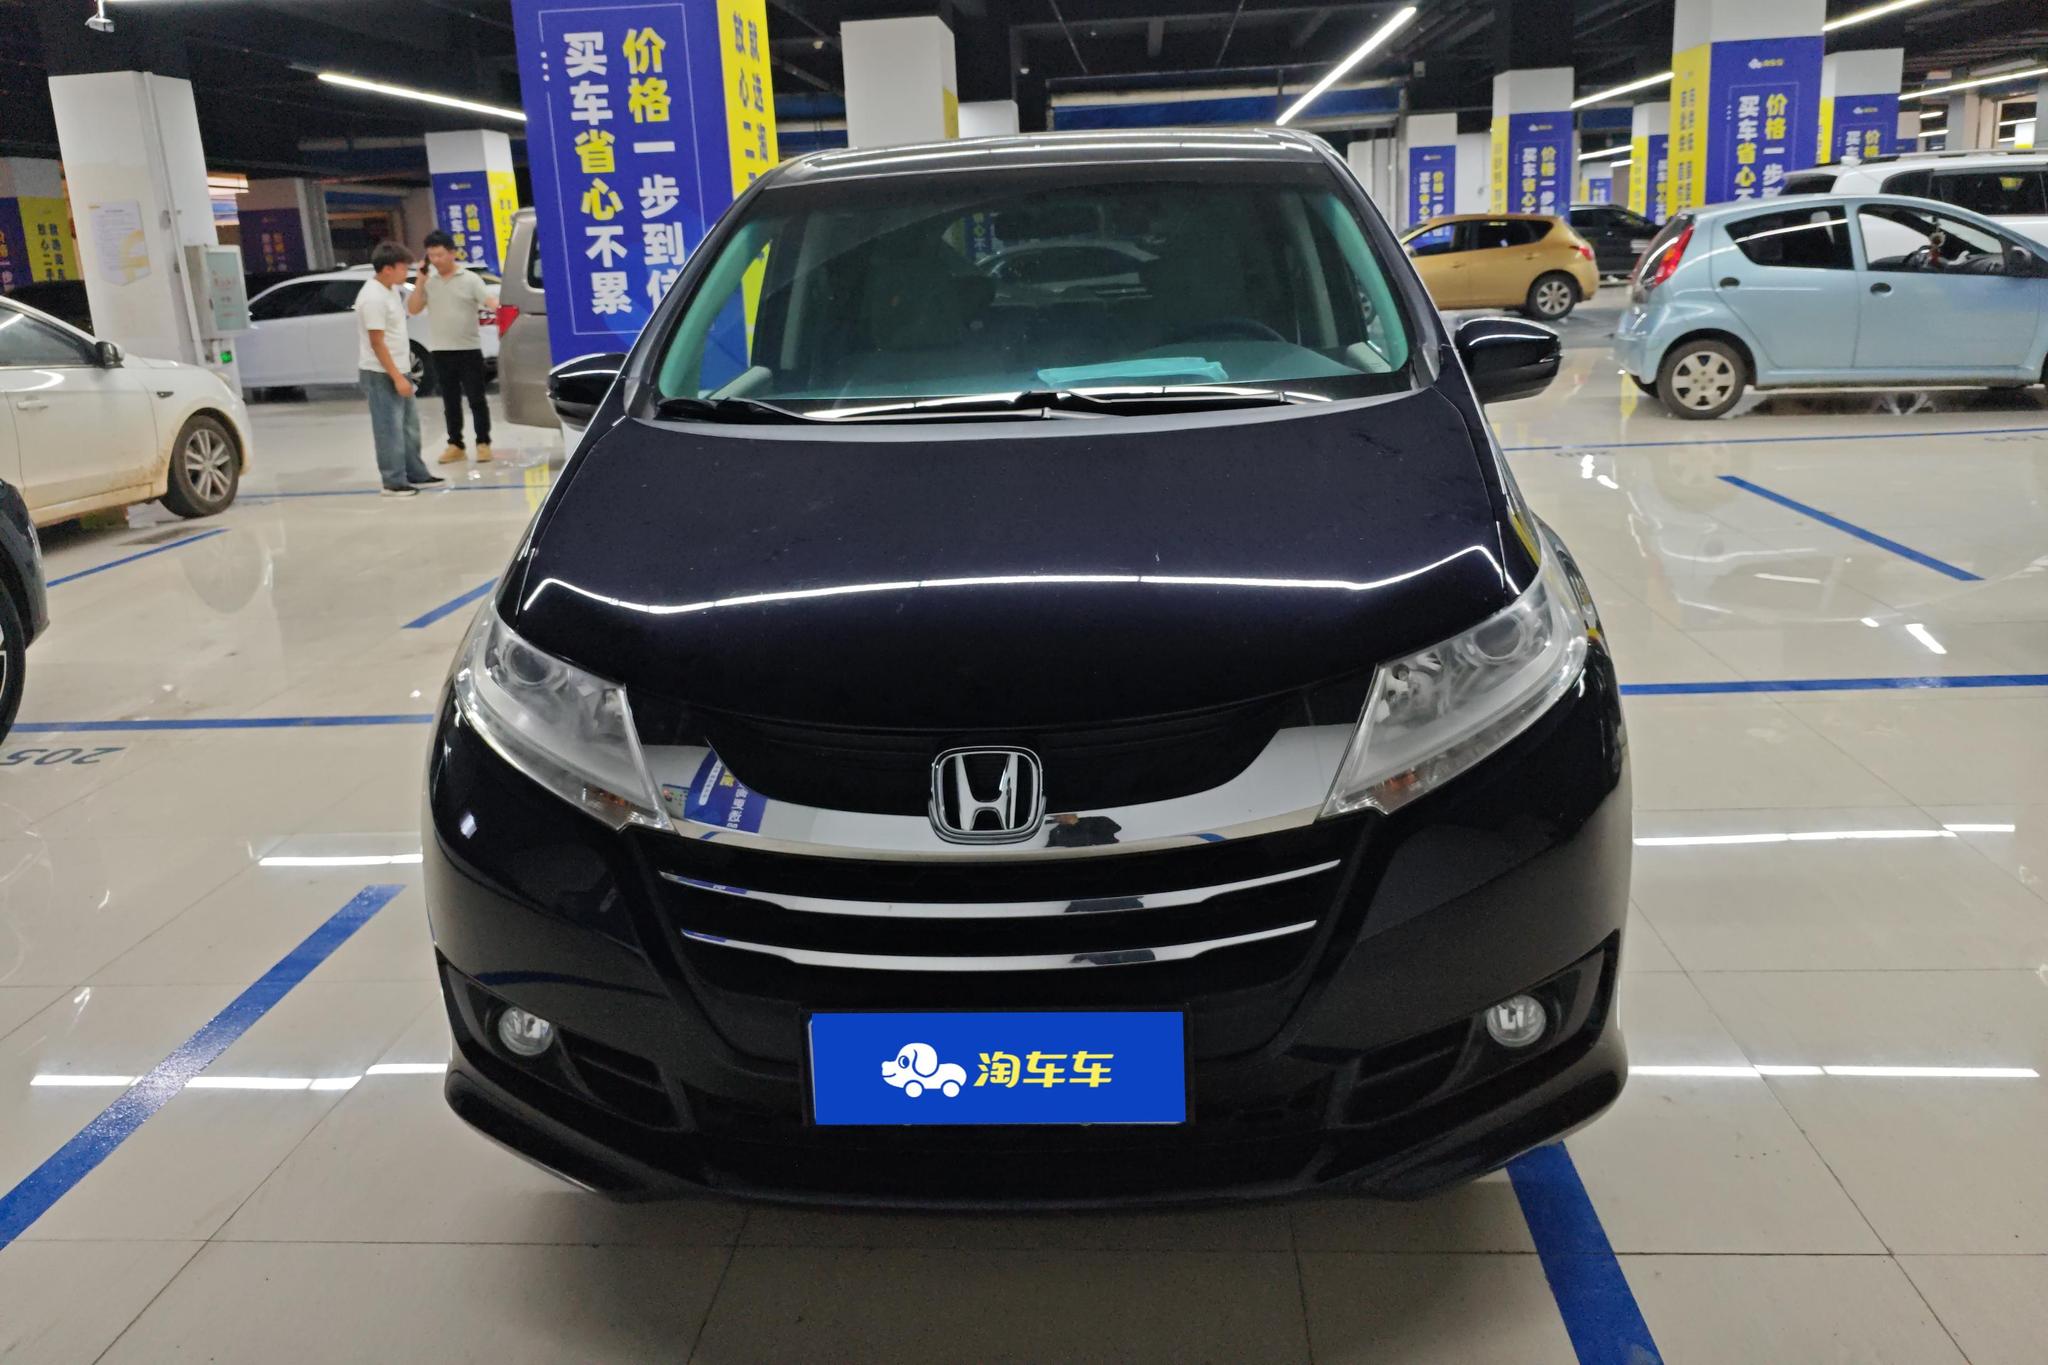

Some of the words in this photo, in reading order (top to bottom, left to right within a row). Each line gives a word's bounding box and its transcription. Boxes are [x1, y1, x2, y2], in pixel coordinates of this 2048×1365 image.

[563, 31, 632, 315] 买车省心不累
